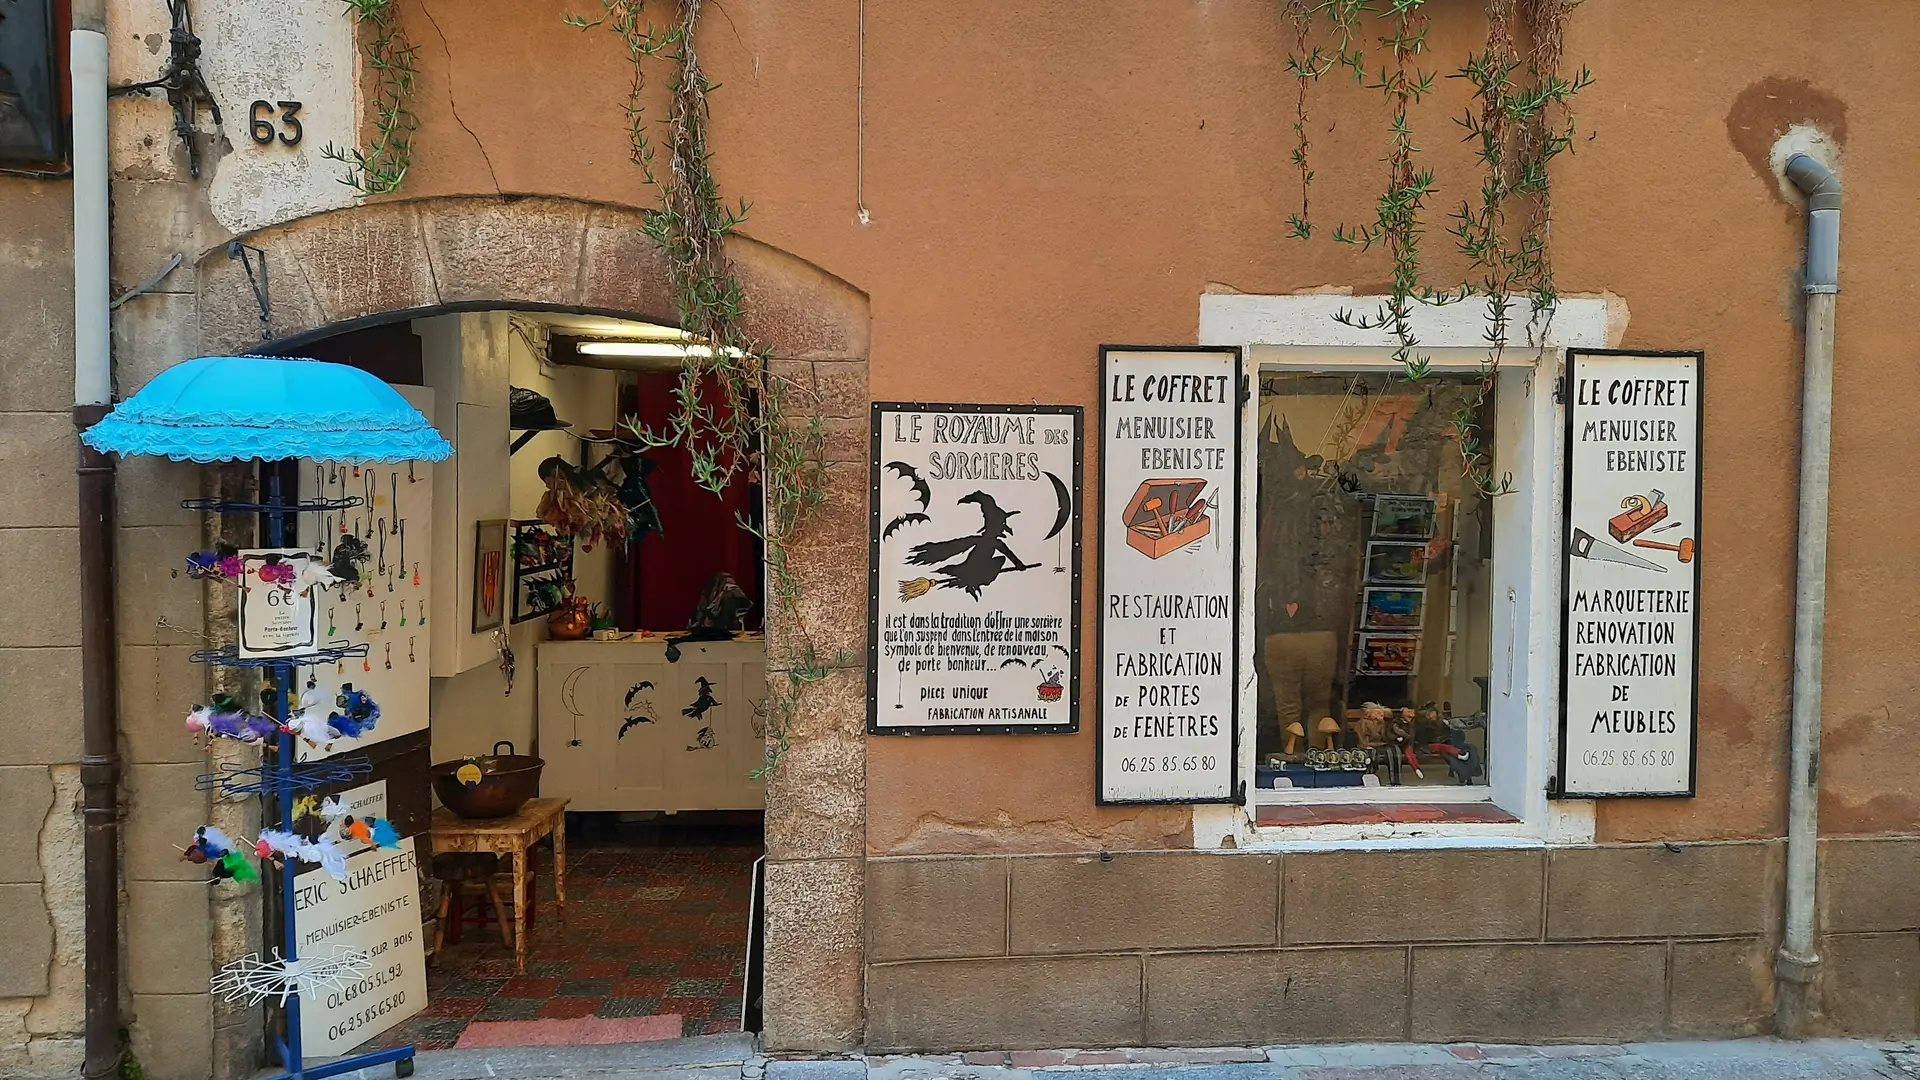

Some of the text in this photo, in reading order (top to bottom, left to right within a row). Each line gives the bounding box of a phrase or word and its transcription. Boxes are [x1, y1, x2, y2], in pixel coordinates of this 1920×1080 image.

[250, 100, 302, 146] 63
[1112, 374, 1228, 404] LE COFFRET
[1578, 379, 1689, 406] LE COFFRET
[894, 414, 1069, 445] LE ROYAUME DES
[1115, 416, 1216, 439] MENUISIER
[1582, 420, 1677, 441] MENUISIER
[1141, 448, 1225, 470] EBENISTE
[1607, 450, 1686, 472] EBENISTE
[1109, 595, 1229, 619] RESTAURATION
[1572, 590, 1690, 614] MARQUETERIE
[893, 613, 907, 628] est
[910, 612, 930, 628] dans
[931, 612, 939, 628] la
[941, 612, 981, 629] tradition
[1014, 616, 1030, 629] une
[1576, 621, 1675, 644] RENOVATION
[884, 630, 898, 644] que
[916, 629, 948, 644] suspend
[952, 629, 971, 642] dans
[1004, 629, 1014, 642] de
[1015, 629, 1022, 642] la
[1025, 629, 1058, 642] maison
[1160, 627, 1177, 645] ET
[884, 642, 1049, 659] symbole de bienvenue, de renouveau,
[898, 657, 911, 671] de
[915, 657, 941, 675] porte
[1116, 652, 1222, 677] FABRICATION
[1575, 653, 1675, 677] FABRICATION
[1115, 685, 1200, 708] DE PORTES
[1612, 685, 1629, 701] DE
[1113, 712, 1219, 738] DE FENÊTRES
[1590, 710, 1676, 734] MEUBLES
[294, 879, 328, 911] ERIC
[305, 895, 410, 946] MENUISIER-EBENISTE
[371, 941, 389, 957] SUR
[393, 931, 413, 948] BOIS
